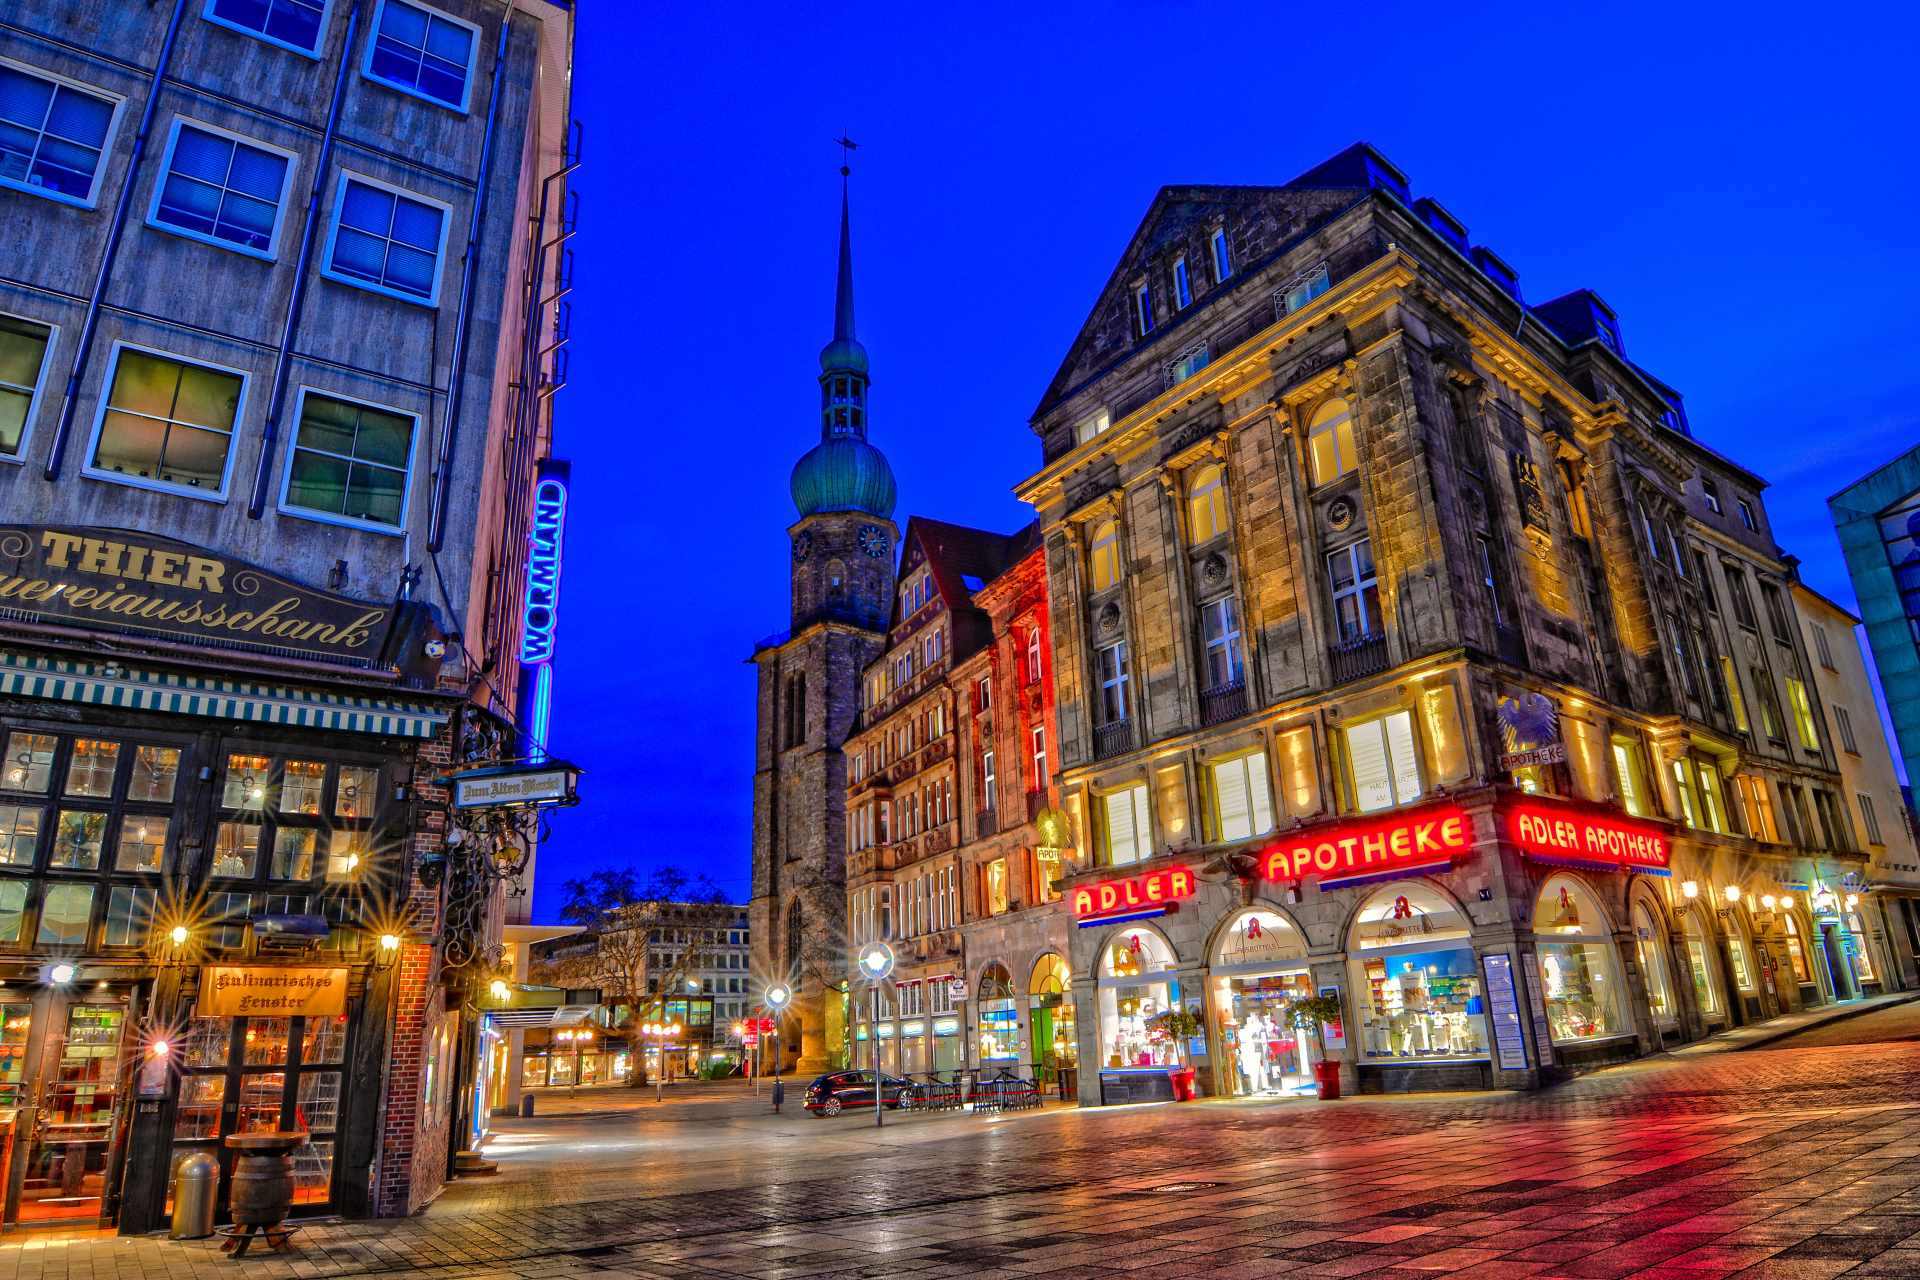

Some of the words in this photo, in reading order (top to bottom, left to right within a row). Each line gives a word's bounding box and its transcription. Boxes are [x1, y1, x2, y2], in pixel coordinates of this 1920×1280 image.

[42, 531, 226, 593] THIER
[521, 481, 566, 662] WORMLAND
[1501, 747, 1564, 768] APOTHEKE
[463, 785, 490, 802] Zum
[490, 781, 520, 799] Alten
[521, 777, 560, 796] Markt
[1267, 816, 1465, 880] APOTHEKE
[1518, 813, 1580, 850] ADLER
[1585, 826, 1665, 863] APOTHEKE
[1075, 871, 1190, 915] ADLER
[215, 972, 333, 990] Kulinarisches
[239, 994, 306, 1012] Fenster
